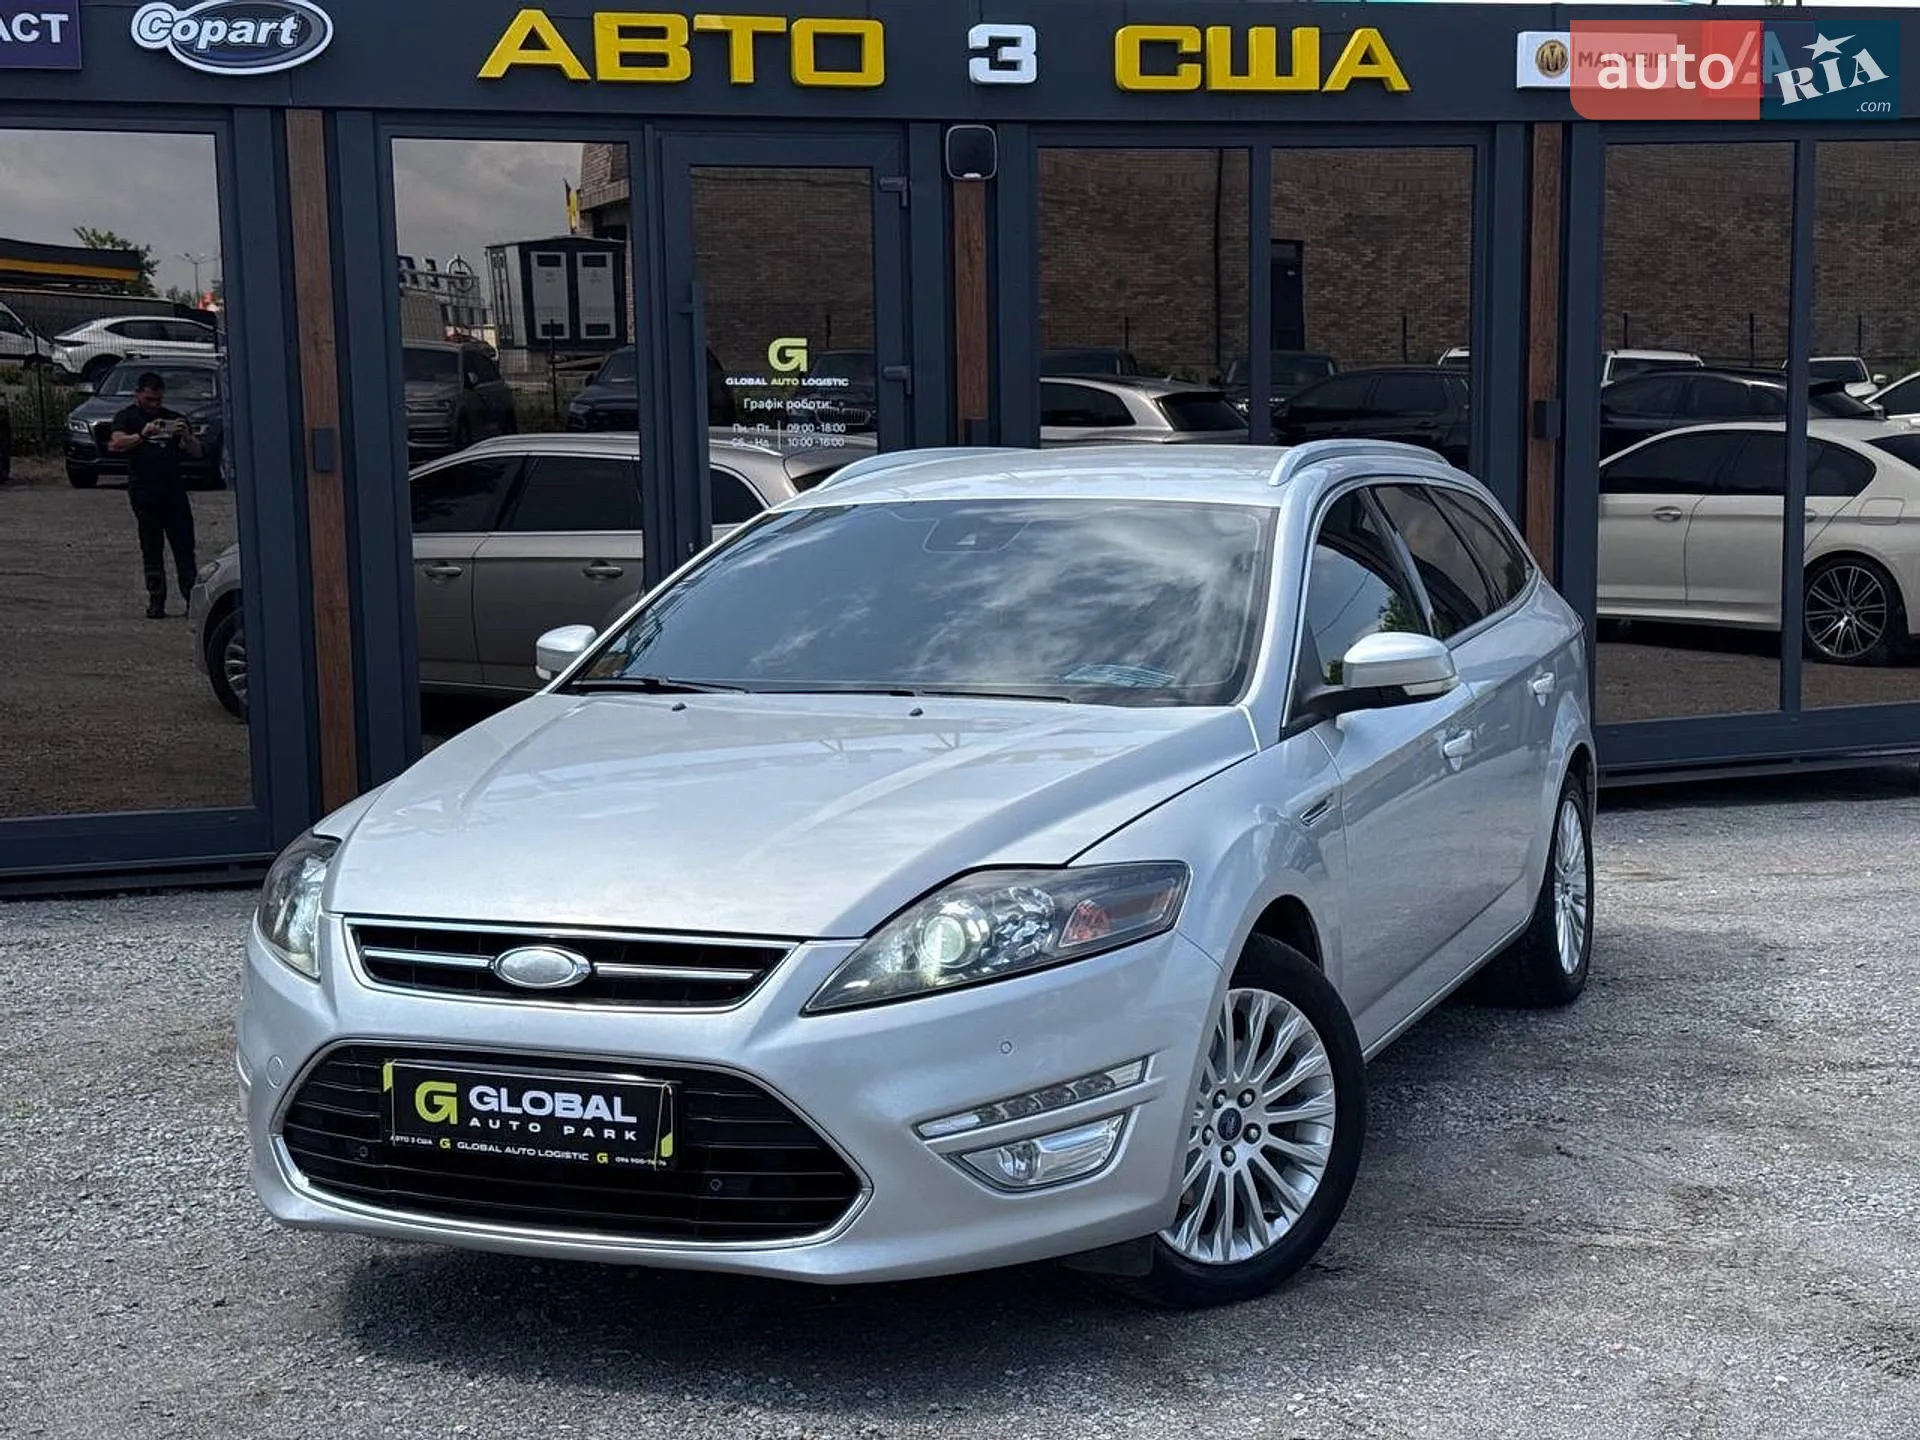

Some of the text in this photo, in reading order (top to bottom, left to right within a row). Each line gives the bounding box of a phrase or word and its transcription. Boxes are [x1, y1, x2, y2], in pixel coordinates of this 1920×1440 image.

[138, 11, 301, 50] Copart
[477, 8, 885, 87] АВТО
[1115, 25, 1411, 92] США
[725, 377, 849, 387] GLOBAL AUTO LOGISTIC
[744, 398, 784, 411] Графік
[469, 1085, 637, 1123] GLOBAL
[469, 1117, 637, 1141] AUTO PARK
[457, 1141, 589, 1161] GLOBAL AUTO LOGISTIC
